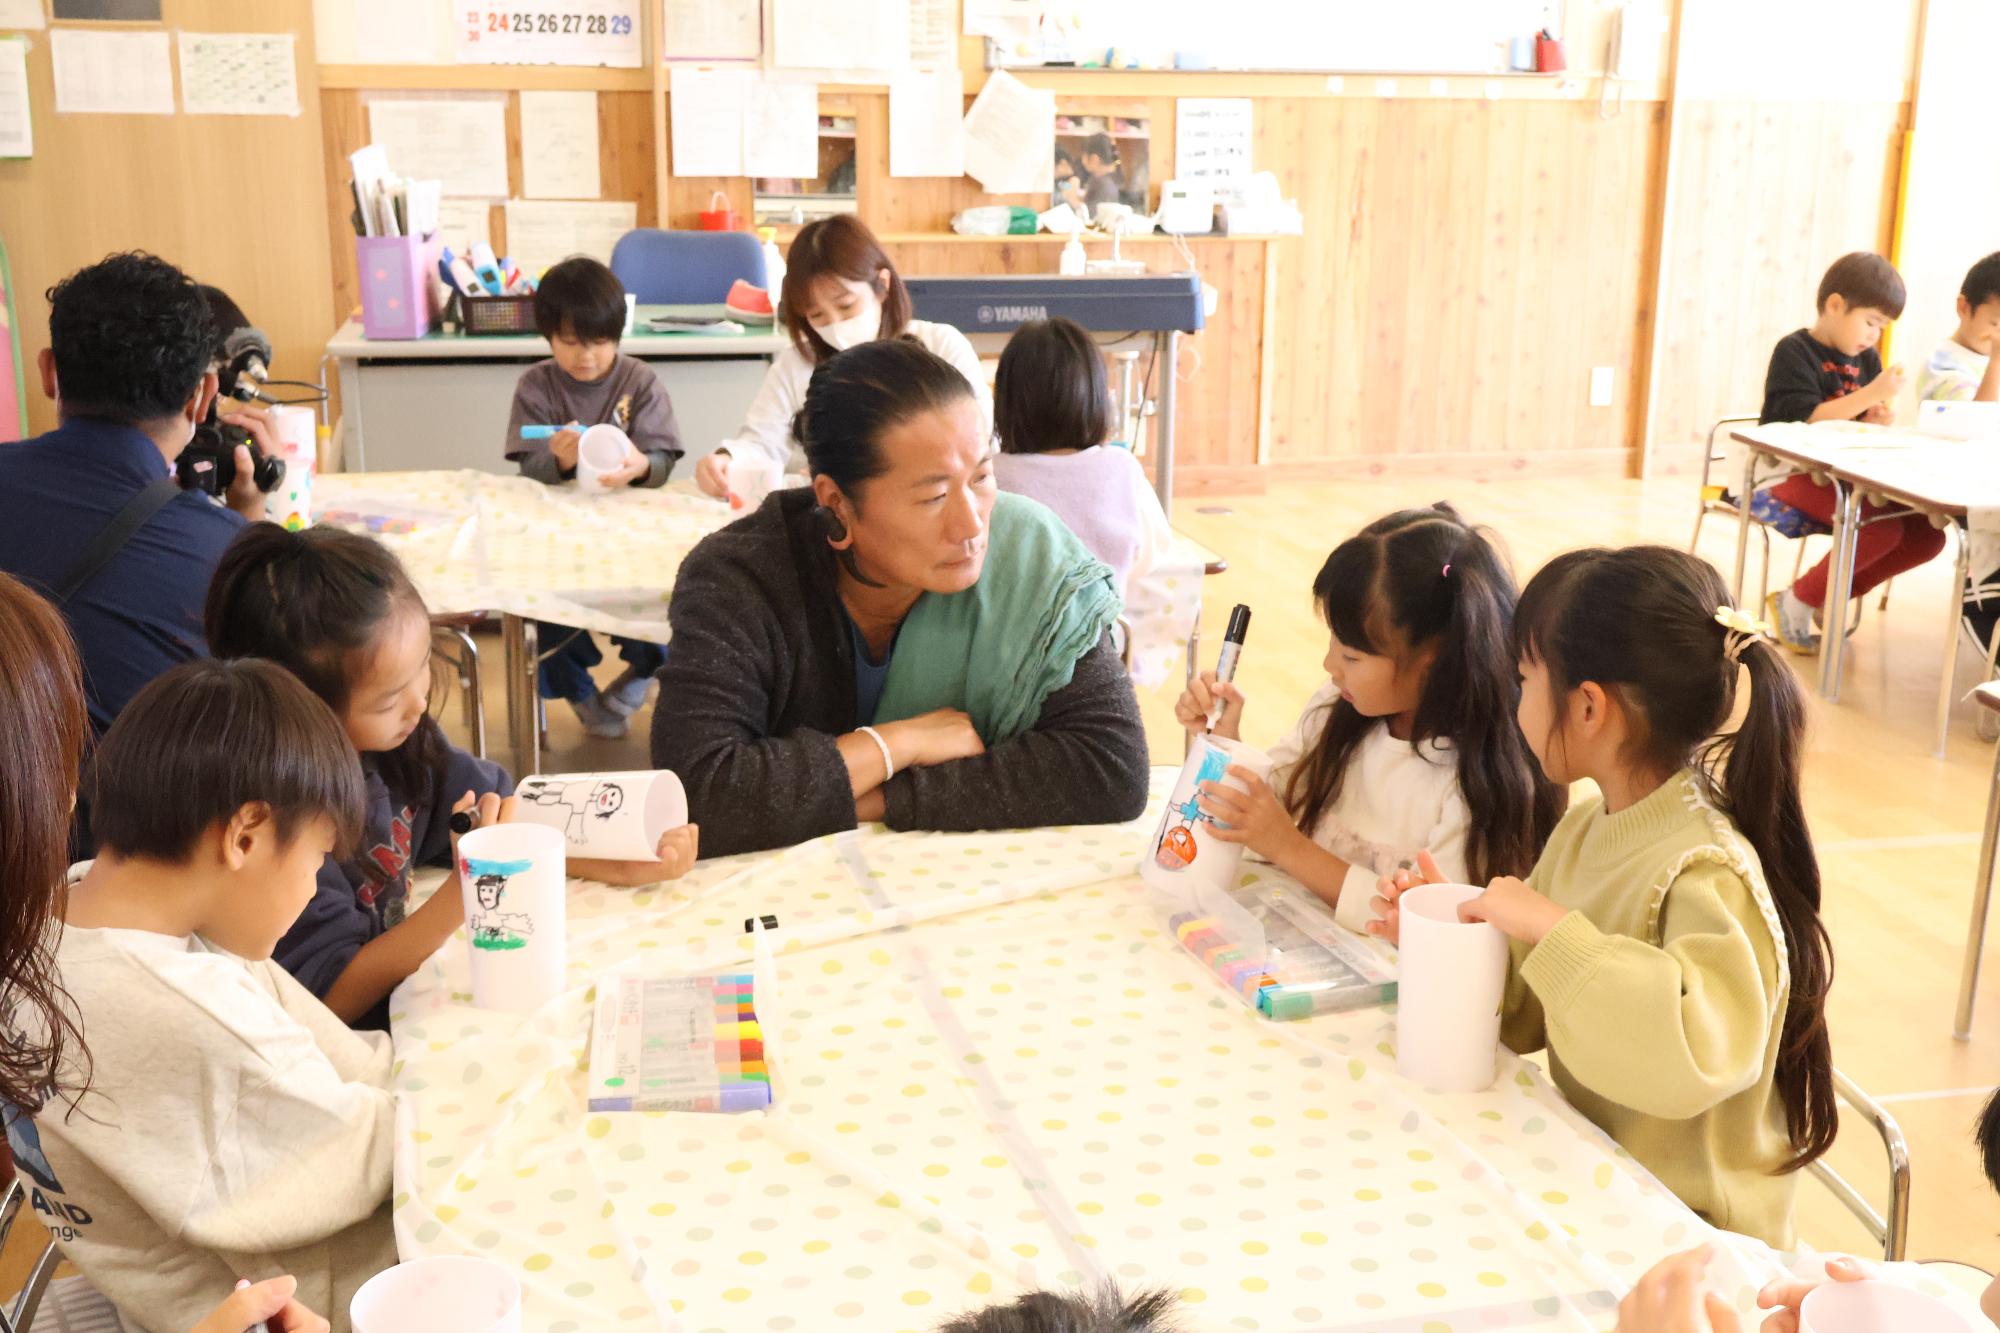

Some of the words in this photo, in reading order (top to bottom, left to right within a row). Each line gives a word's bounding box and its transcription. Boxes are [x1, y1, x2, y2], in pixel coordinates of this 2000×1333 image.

[487, 12, 509, 33] 24
[513, 13, 533, 33] 25
[538, 13, 558, 34] 26
[562, 14, 581, 34] 27
[587, 14, 607, 35] 28
[611, 15, 632, 35] 29
[994, 305, 1047, 322] YAMAHA
